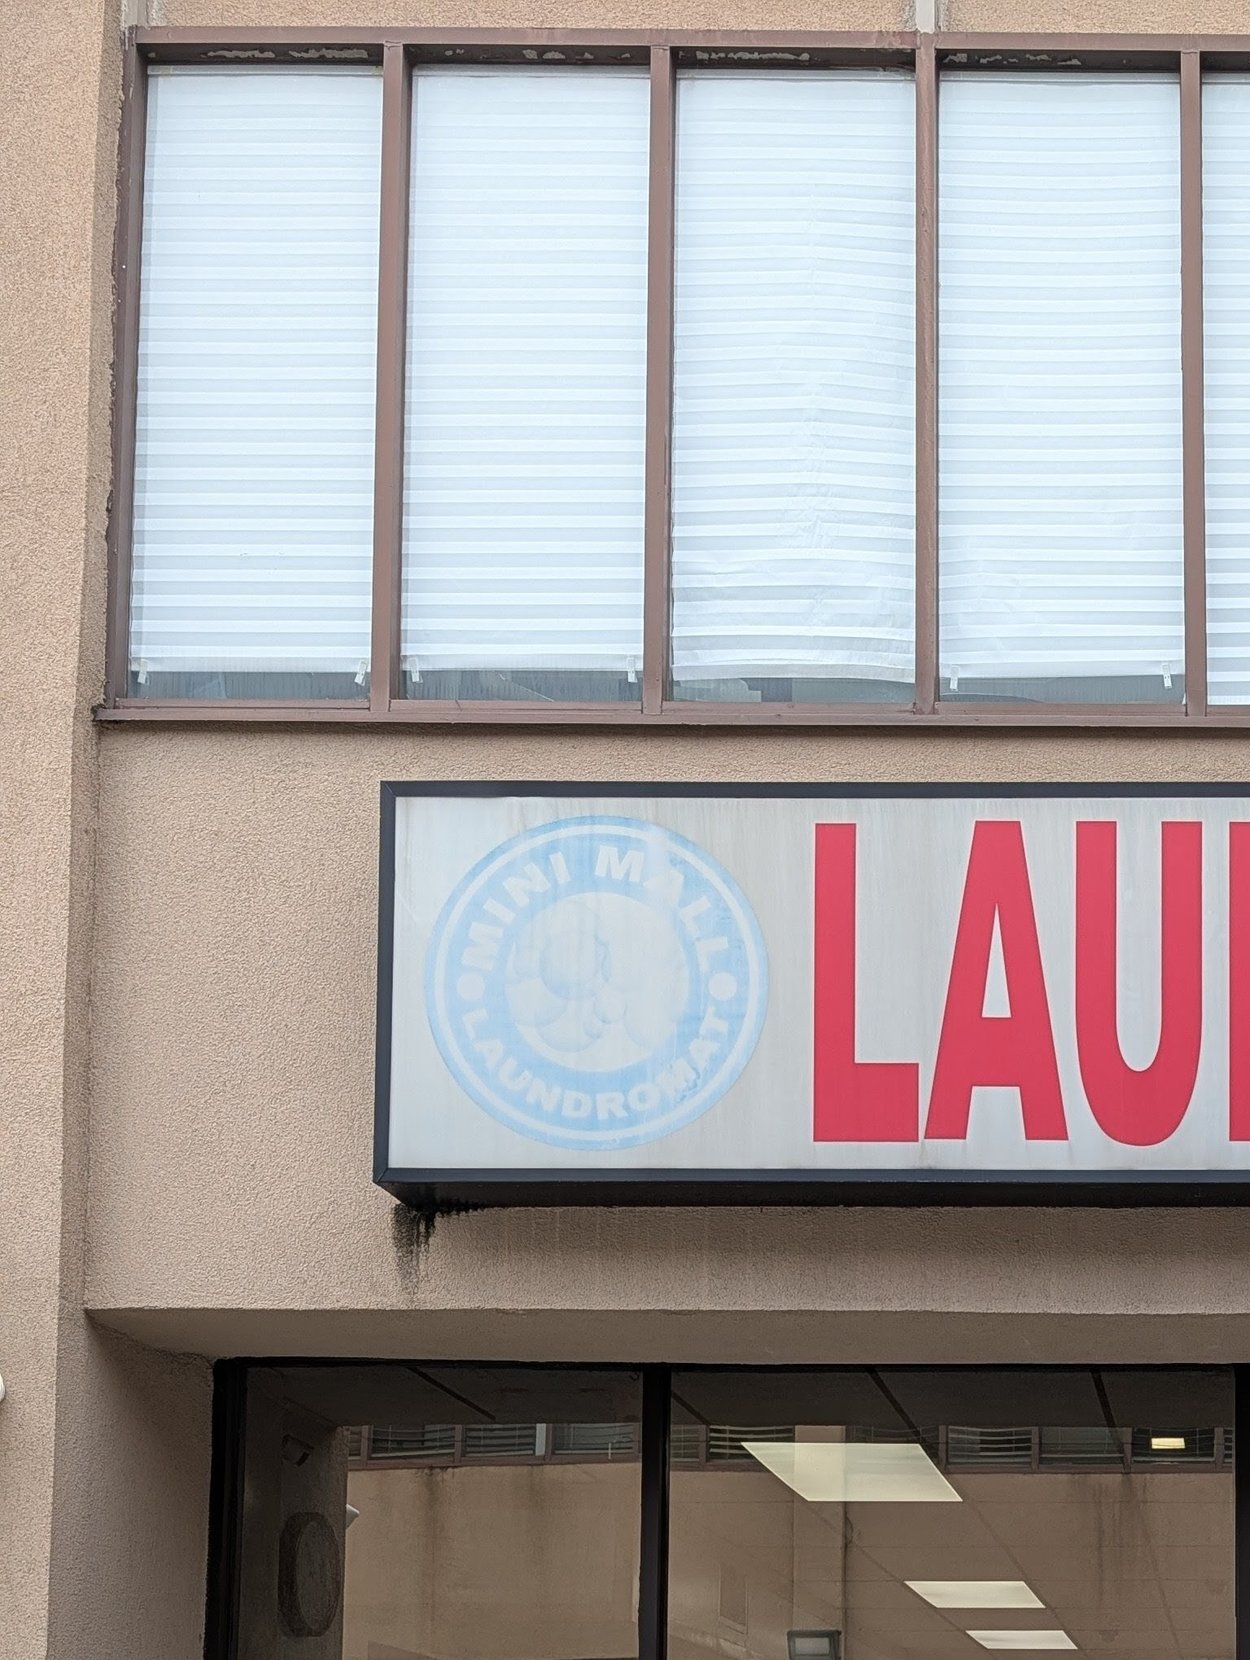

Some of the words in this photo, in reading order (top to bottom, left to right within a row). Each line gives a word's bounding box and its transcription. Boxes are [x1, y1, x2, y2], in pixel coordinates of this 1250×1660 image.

[465, 850, 570, 973] MINI
[593, 844, 730, 970] MALL
[461, 1006, 733, 1122] LAUNDROMAT
